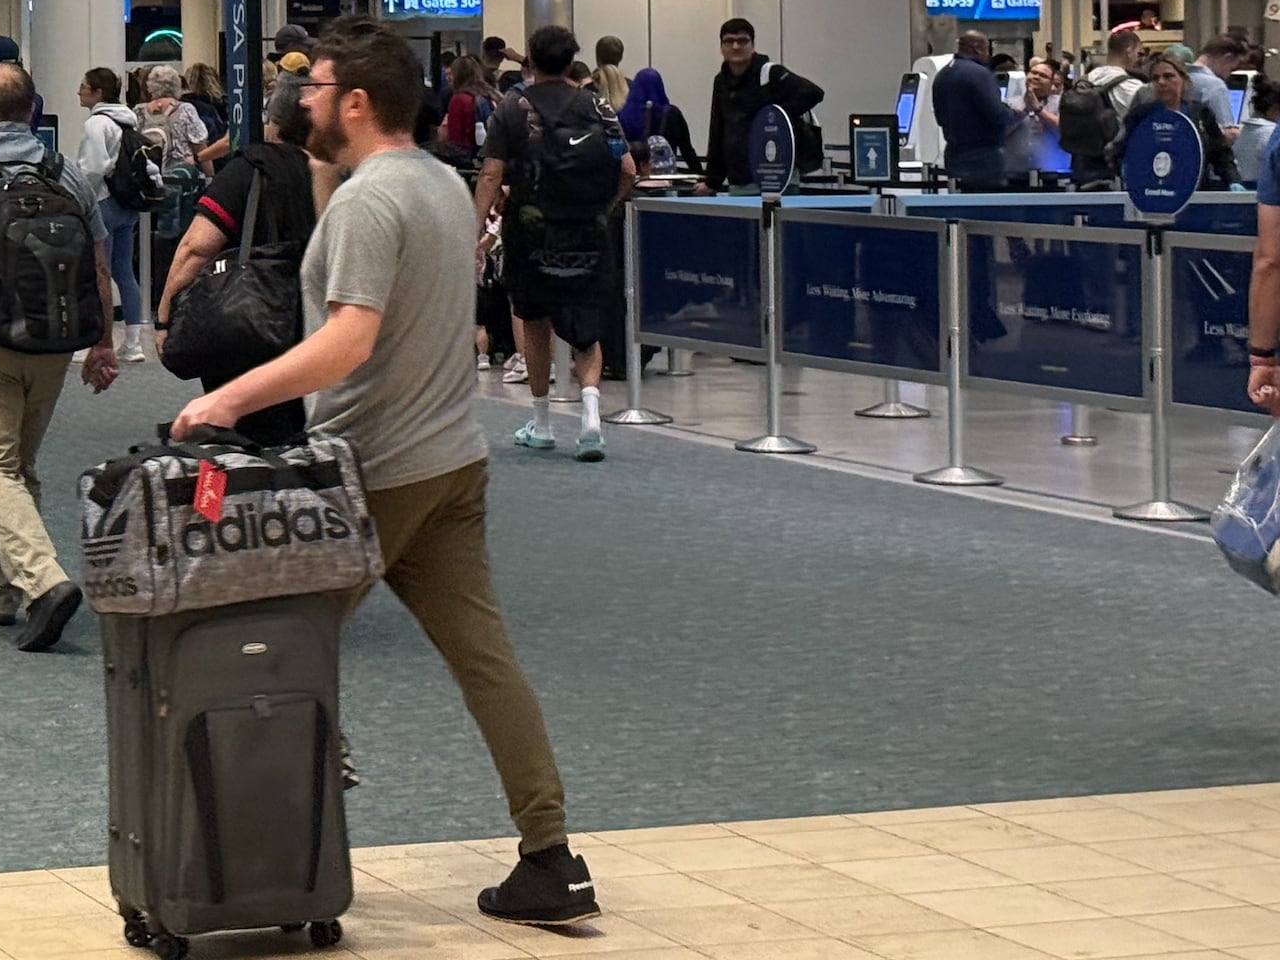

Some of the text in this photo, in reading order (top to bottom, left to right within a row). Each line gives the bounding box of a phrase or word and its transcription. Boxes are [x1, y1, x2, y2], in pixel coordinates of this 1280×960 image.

[232, 63, 245, 125] Pre
[1204, 320, 1224, 336] Less
[182, 501, 351, 558] adidas
